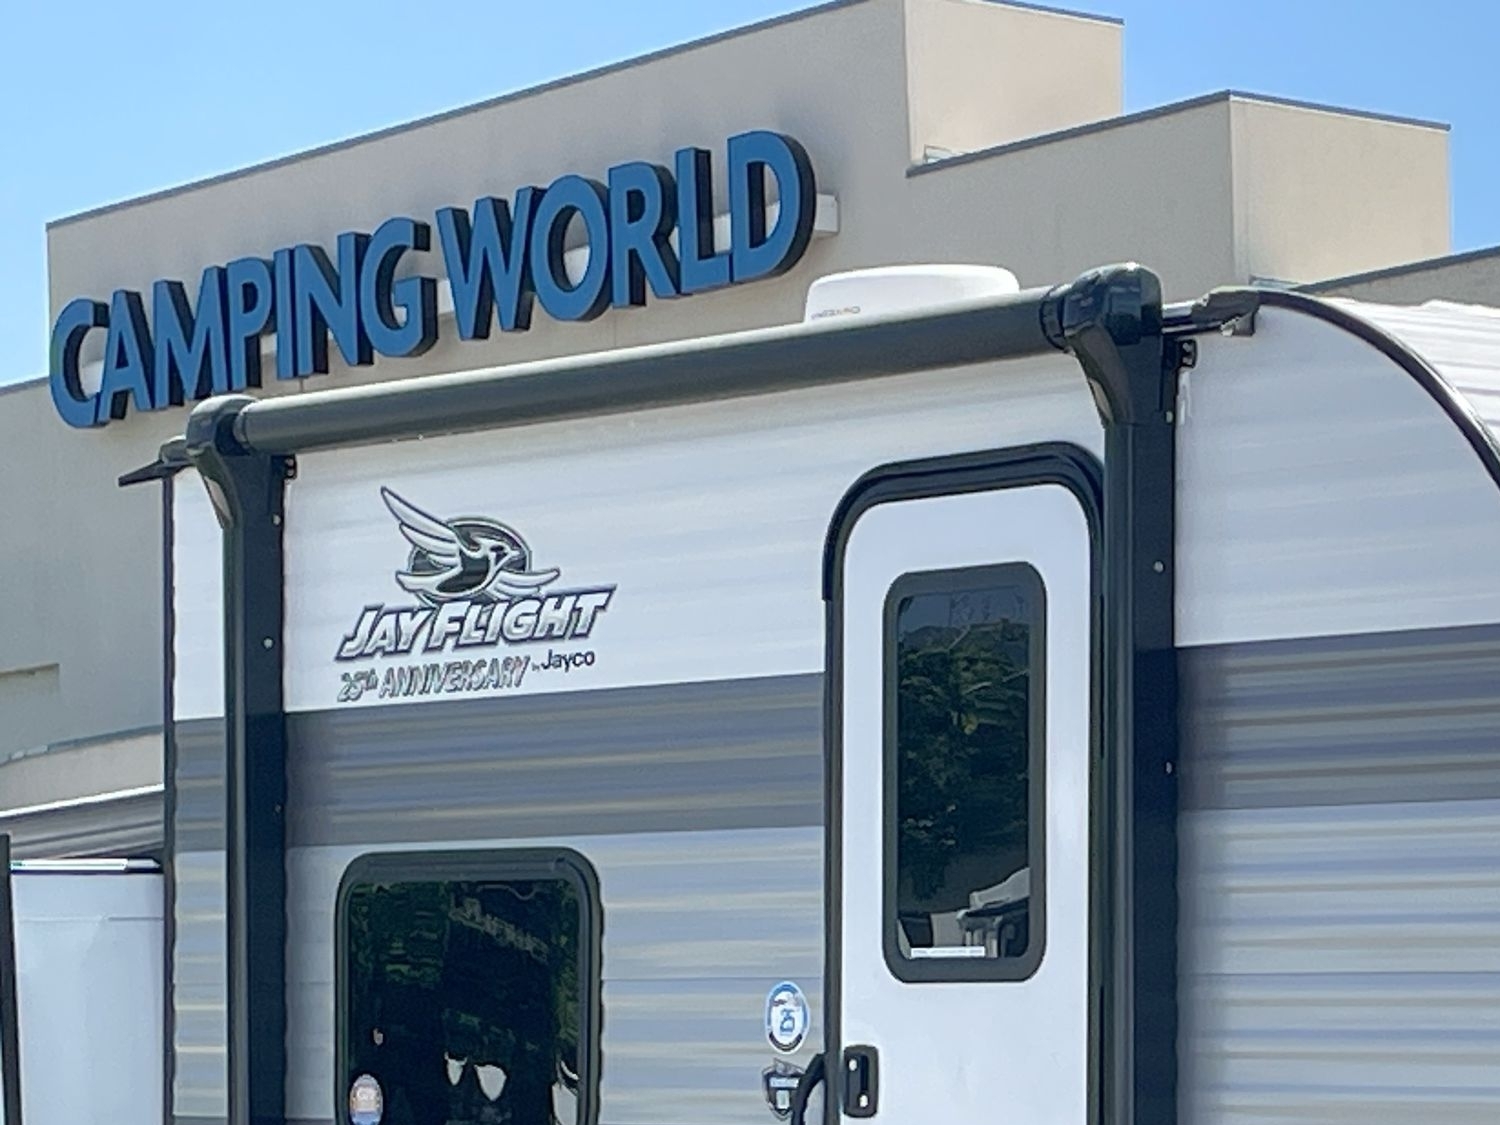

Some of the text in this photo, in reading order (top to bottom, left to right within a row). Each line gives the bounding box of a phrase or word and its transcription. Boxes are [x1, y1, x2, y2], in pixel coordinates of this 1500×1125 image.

[49, 129, 817, 428] CAMPING WORLD
[335, 584, 617, 661] JAY FLIGHT
[378, 655, 531, 699] ANNIVERSARY
[541, 649, 596, 673] Jayco
